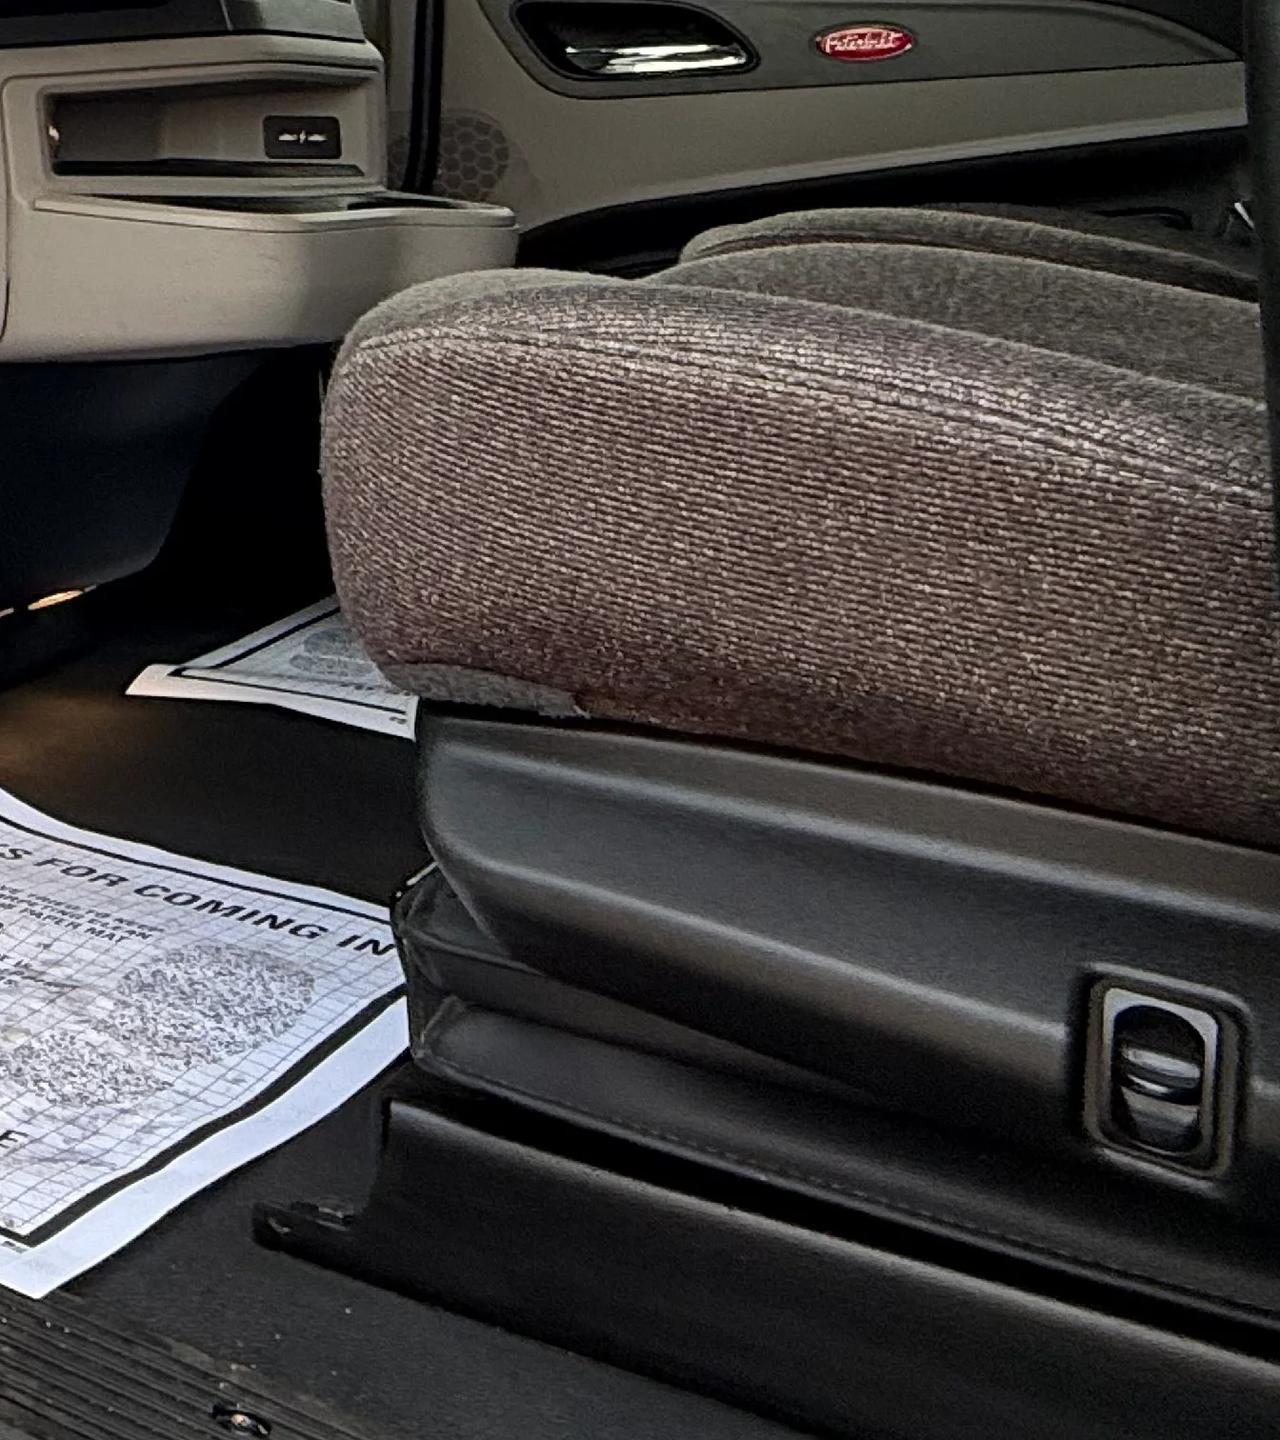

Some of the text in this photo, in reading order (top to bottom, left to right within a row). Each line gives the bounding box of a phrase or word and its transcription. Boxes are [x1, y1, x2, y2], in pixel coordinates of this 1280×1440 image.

[33, 858, 128, 887] FOR
[134, 884, 329, 939] COMING
[336, 934, 395, 956] IN
